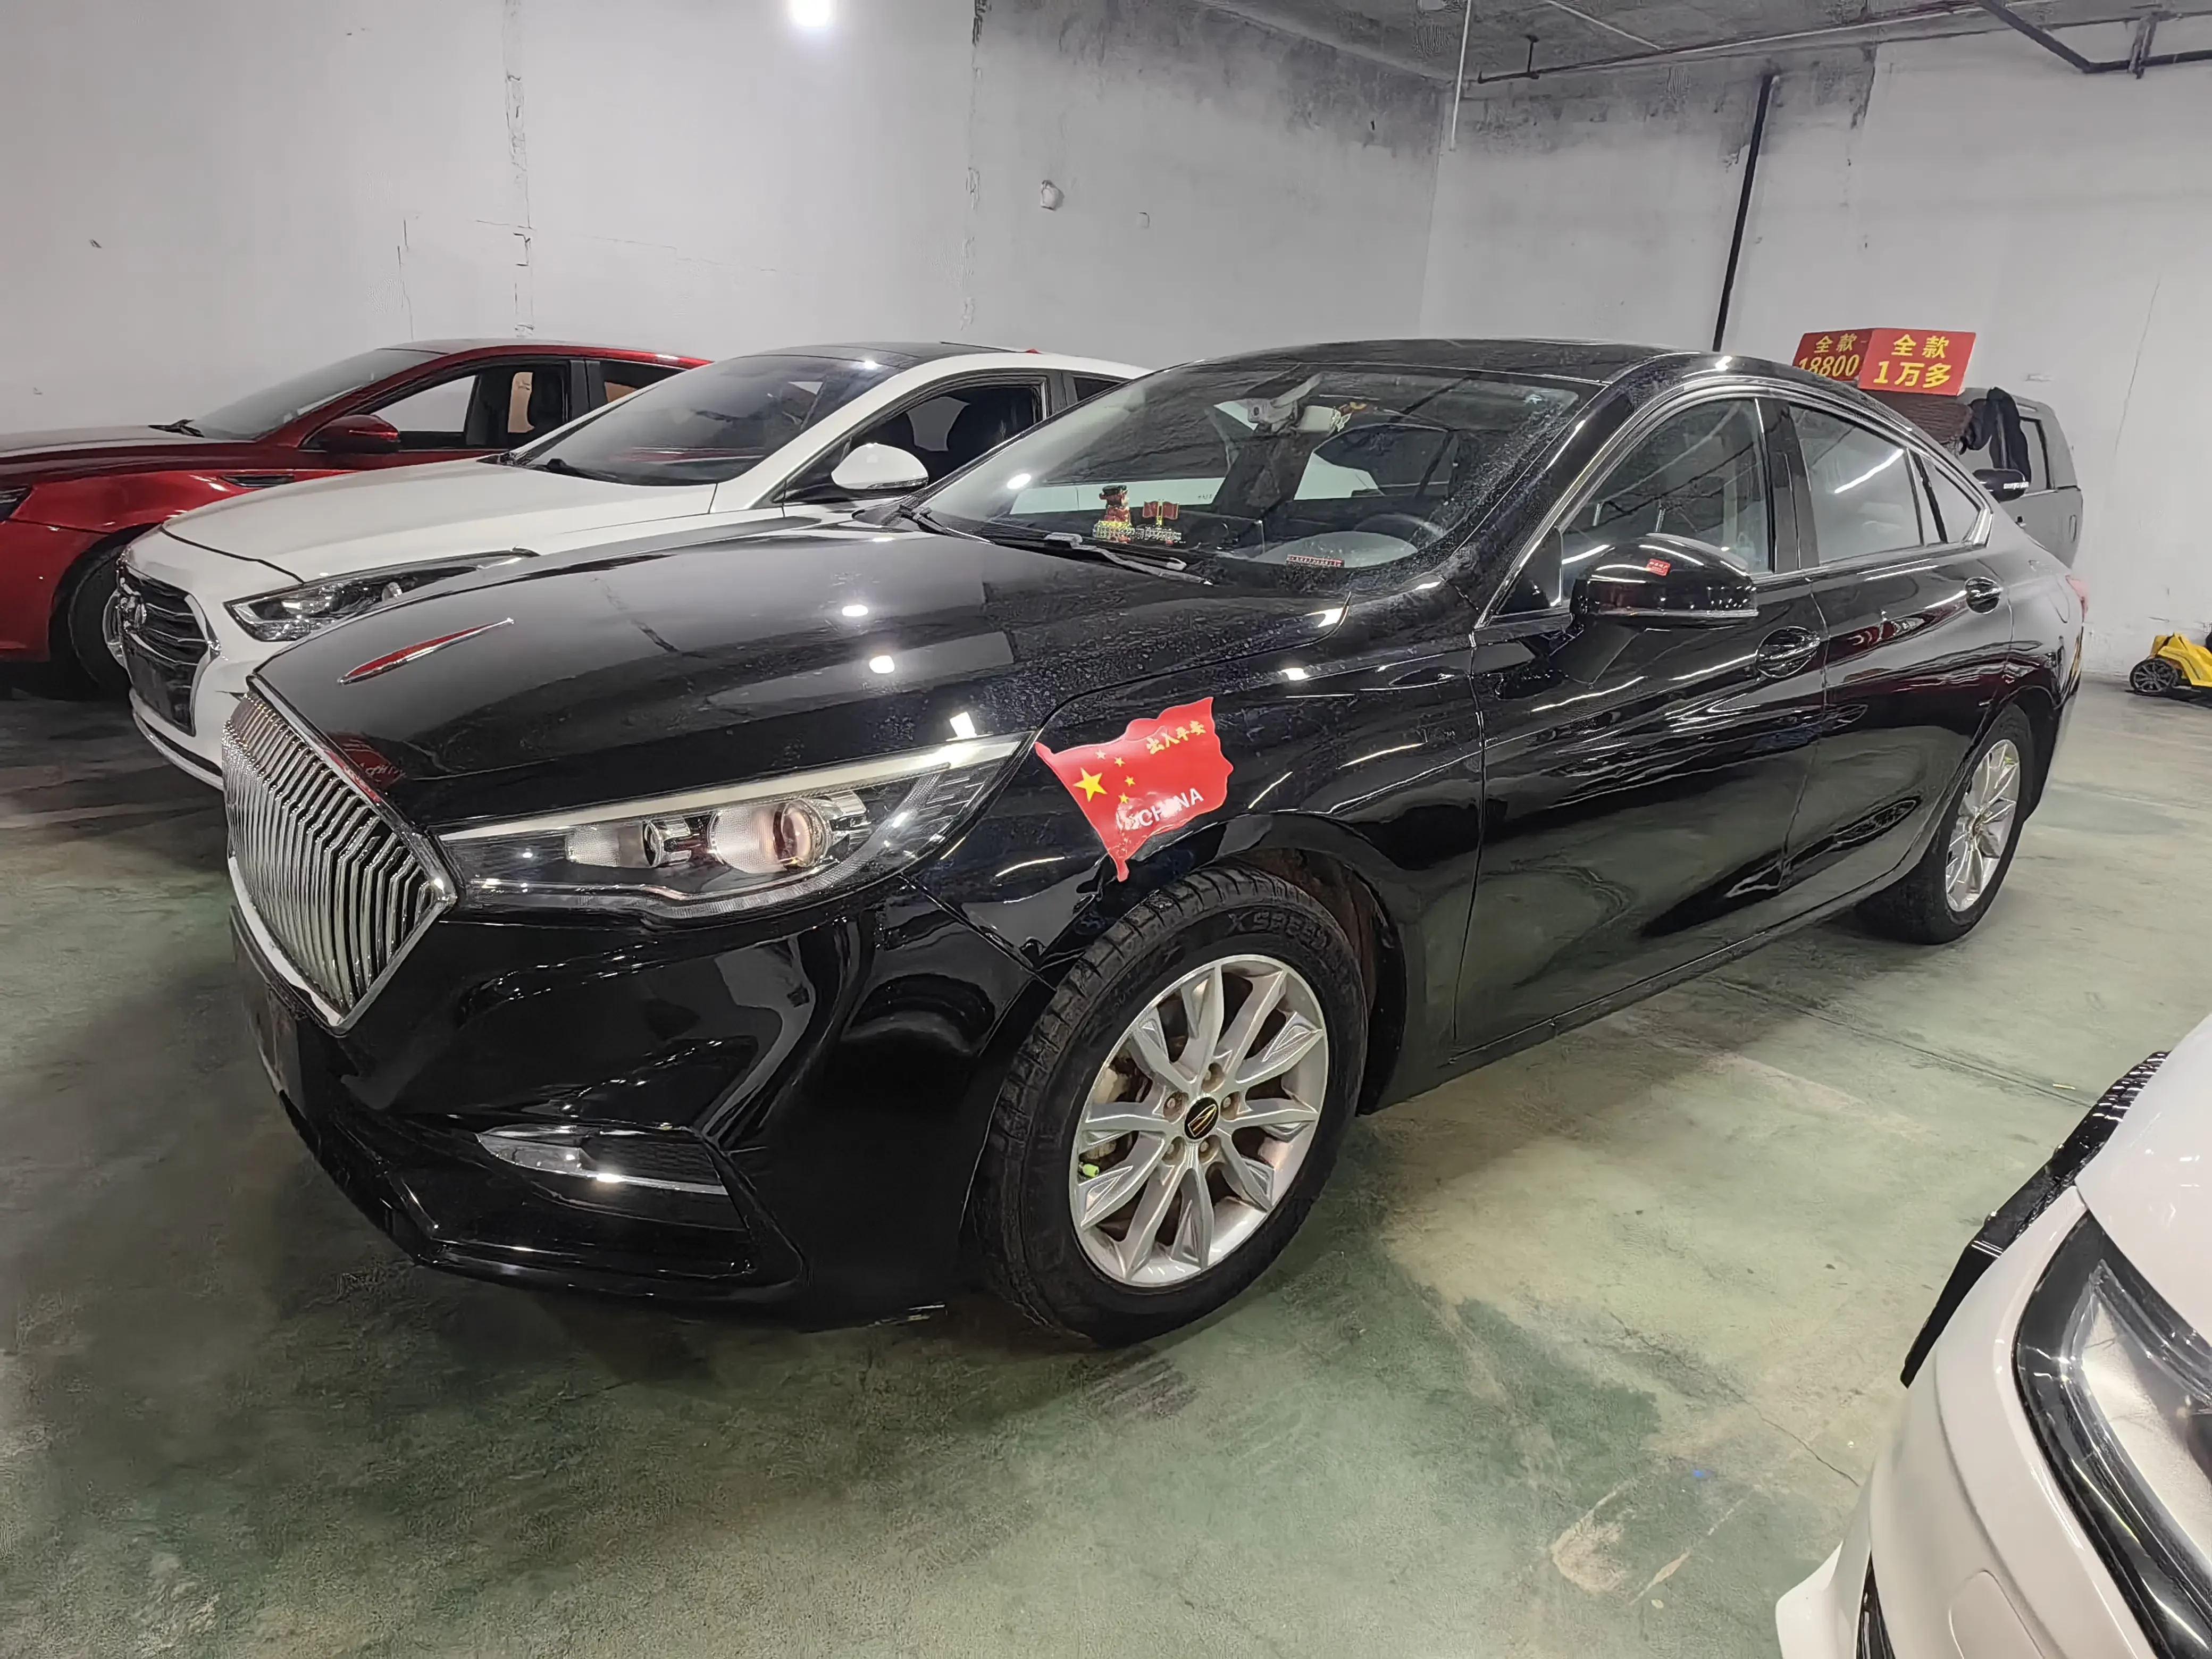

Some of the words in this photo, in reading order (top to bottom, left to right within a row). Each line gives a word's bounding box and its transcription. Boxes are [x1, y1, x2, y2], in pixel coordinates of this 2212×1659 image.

[1814, 333, 1857, 353] 全款
[1891, 333, 1949, 358] 全款
[1799, 354, 1859, 376] 18800
[1873, 361, 1952, 388] 1万多
[1146, 720, 1206, 755] 出入平安
[1138, 787, 1204, 827] CHNA
